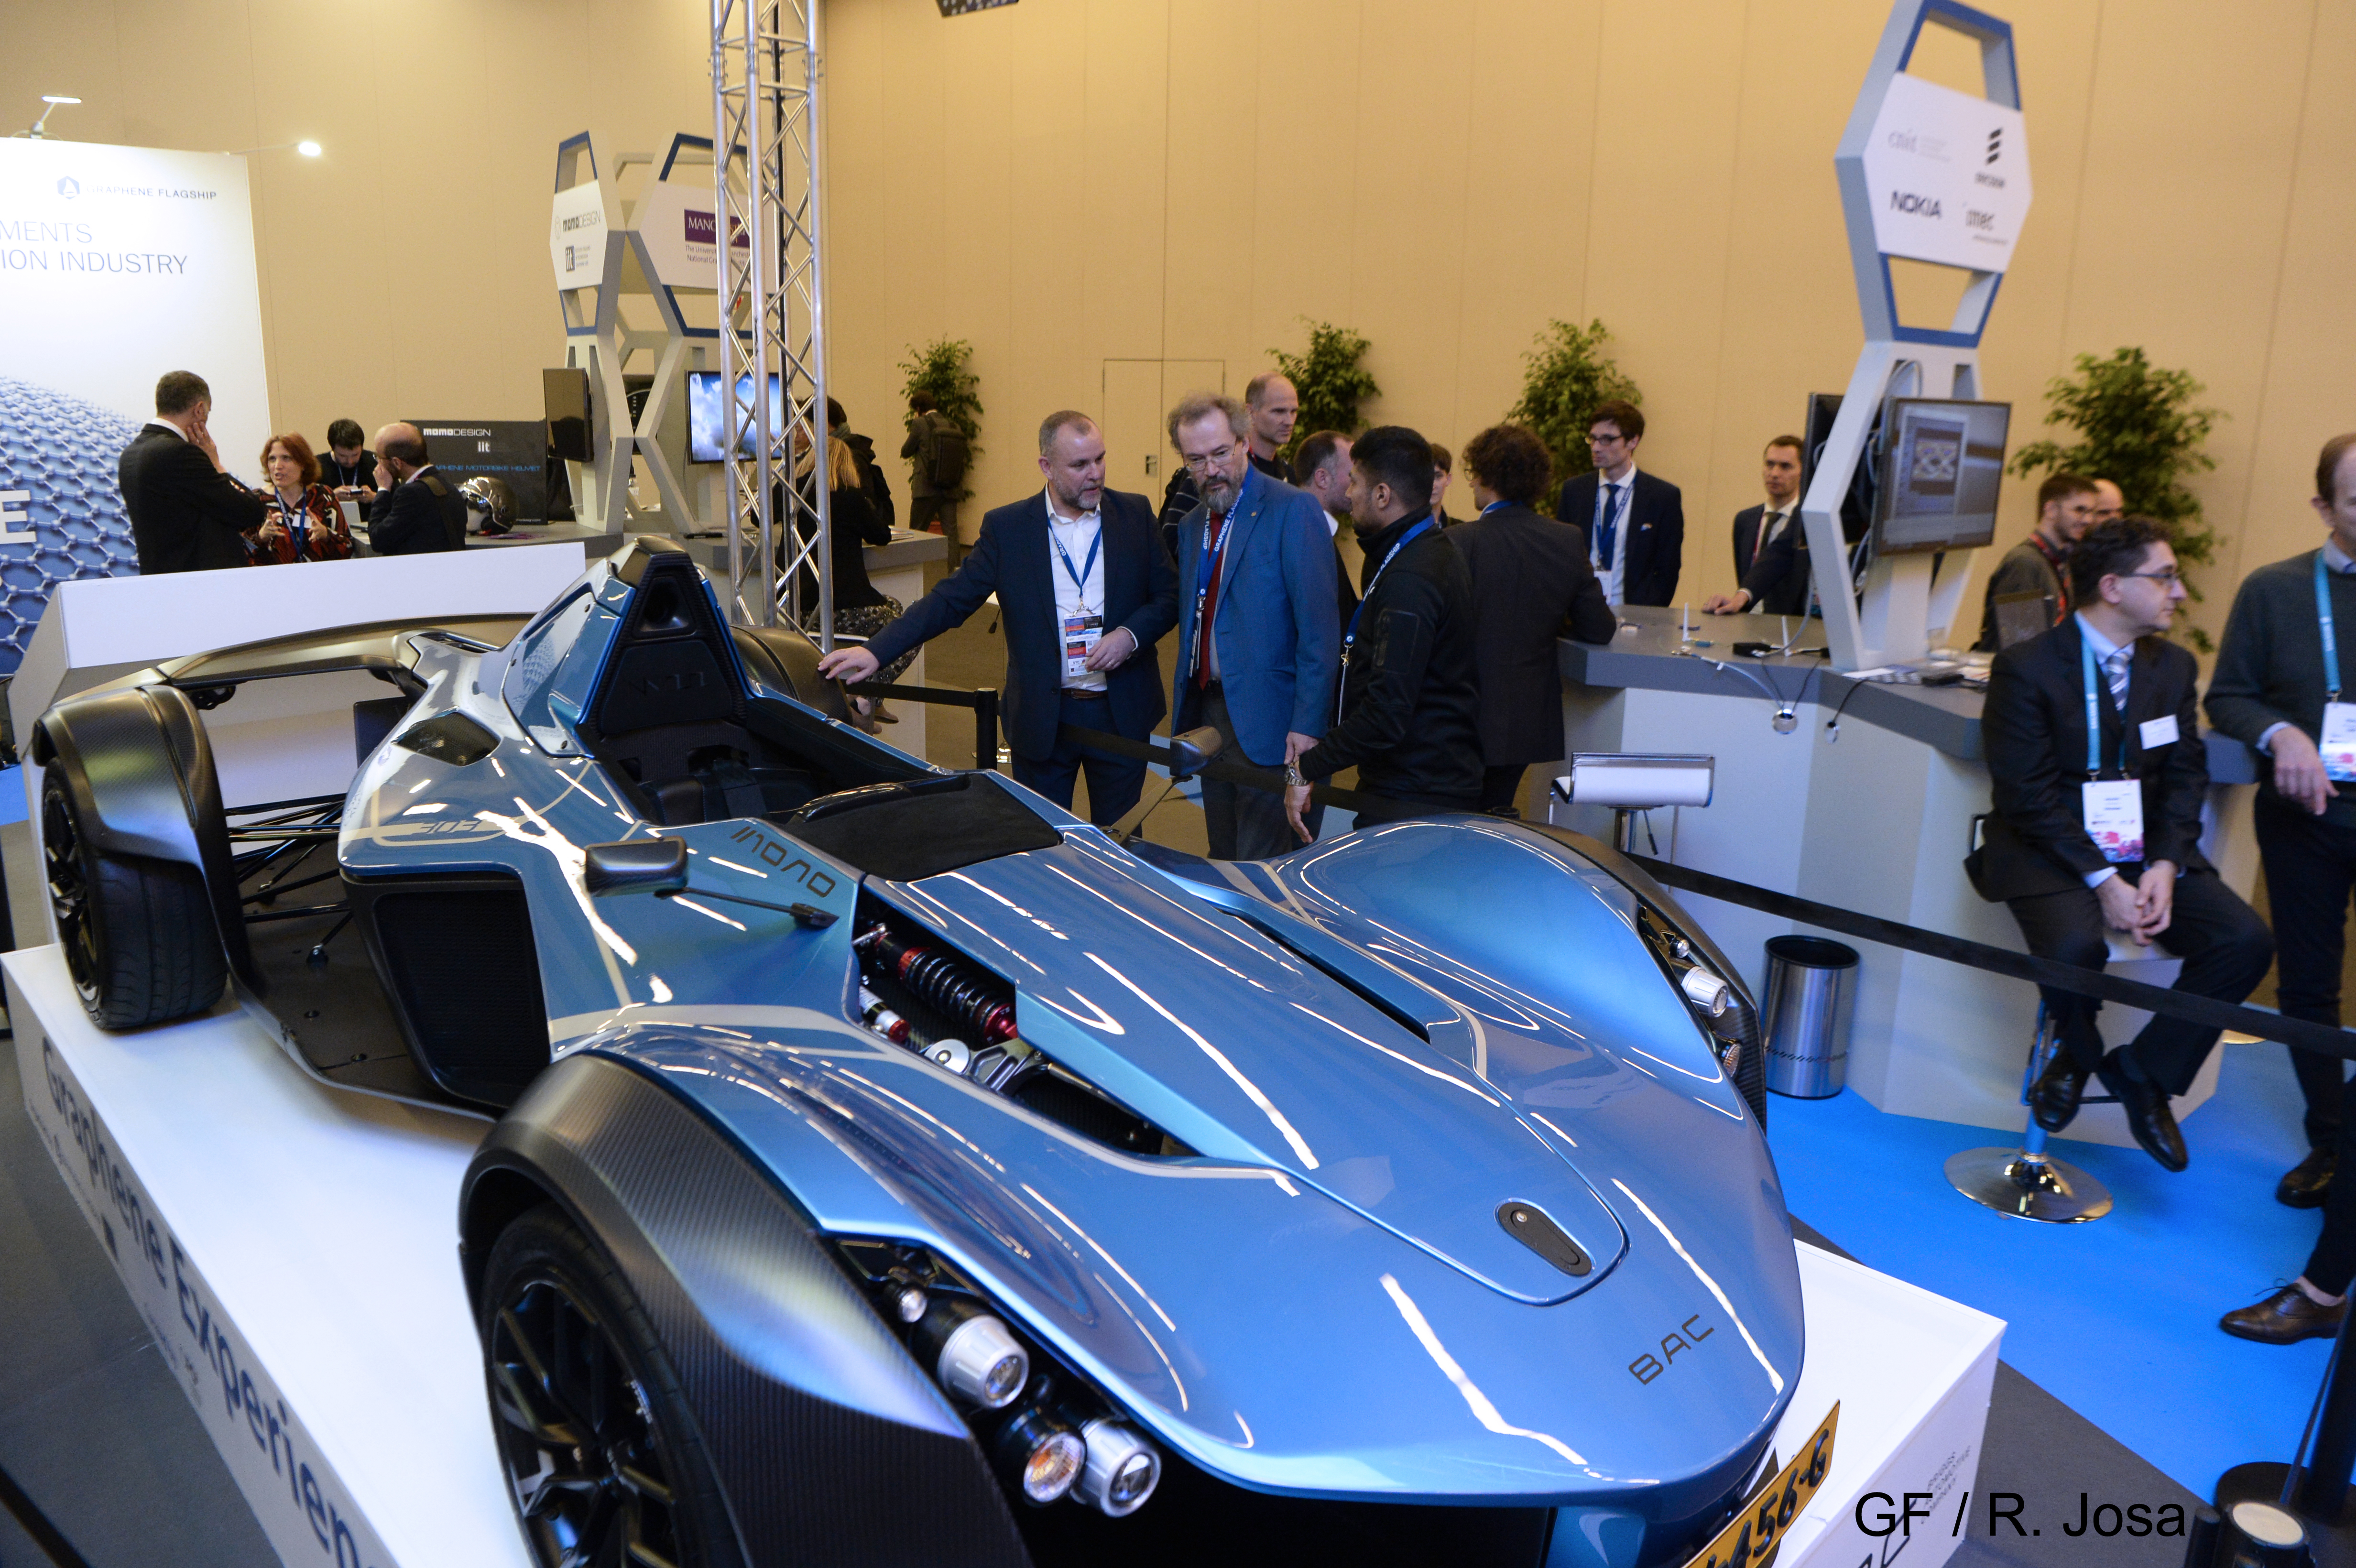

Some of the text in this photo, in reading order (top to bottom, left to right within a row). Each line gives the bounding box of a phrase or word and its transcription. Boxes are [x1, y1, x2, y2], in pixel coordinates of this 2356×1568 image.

[87, 185, 217, 199] GRAPHENE FLAGSHIP
[1890, 190, 1942, 219] NOKIA
[1, 249, 187, 274] ION INDUSTRY
[687, 254, 708, 262] National
[1214, 518, 1231, 552] GRAPHENE
[42, 1036, 167, 1290] Graphene
[168, 1232, 377, 1568] Experien
[1628, 1314, 1714, 1385] BAC
